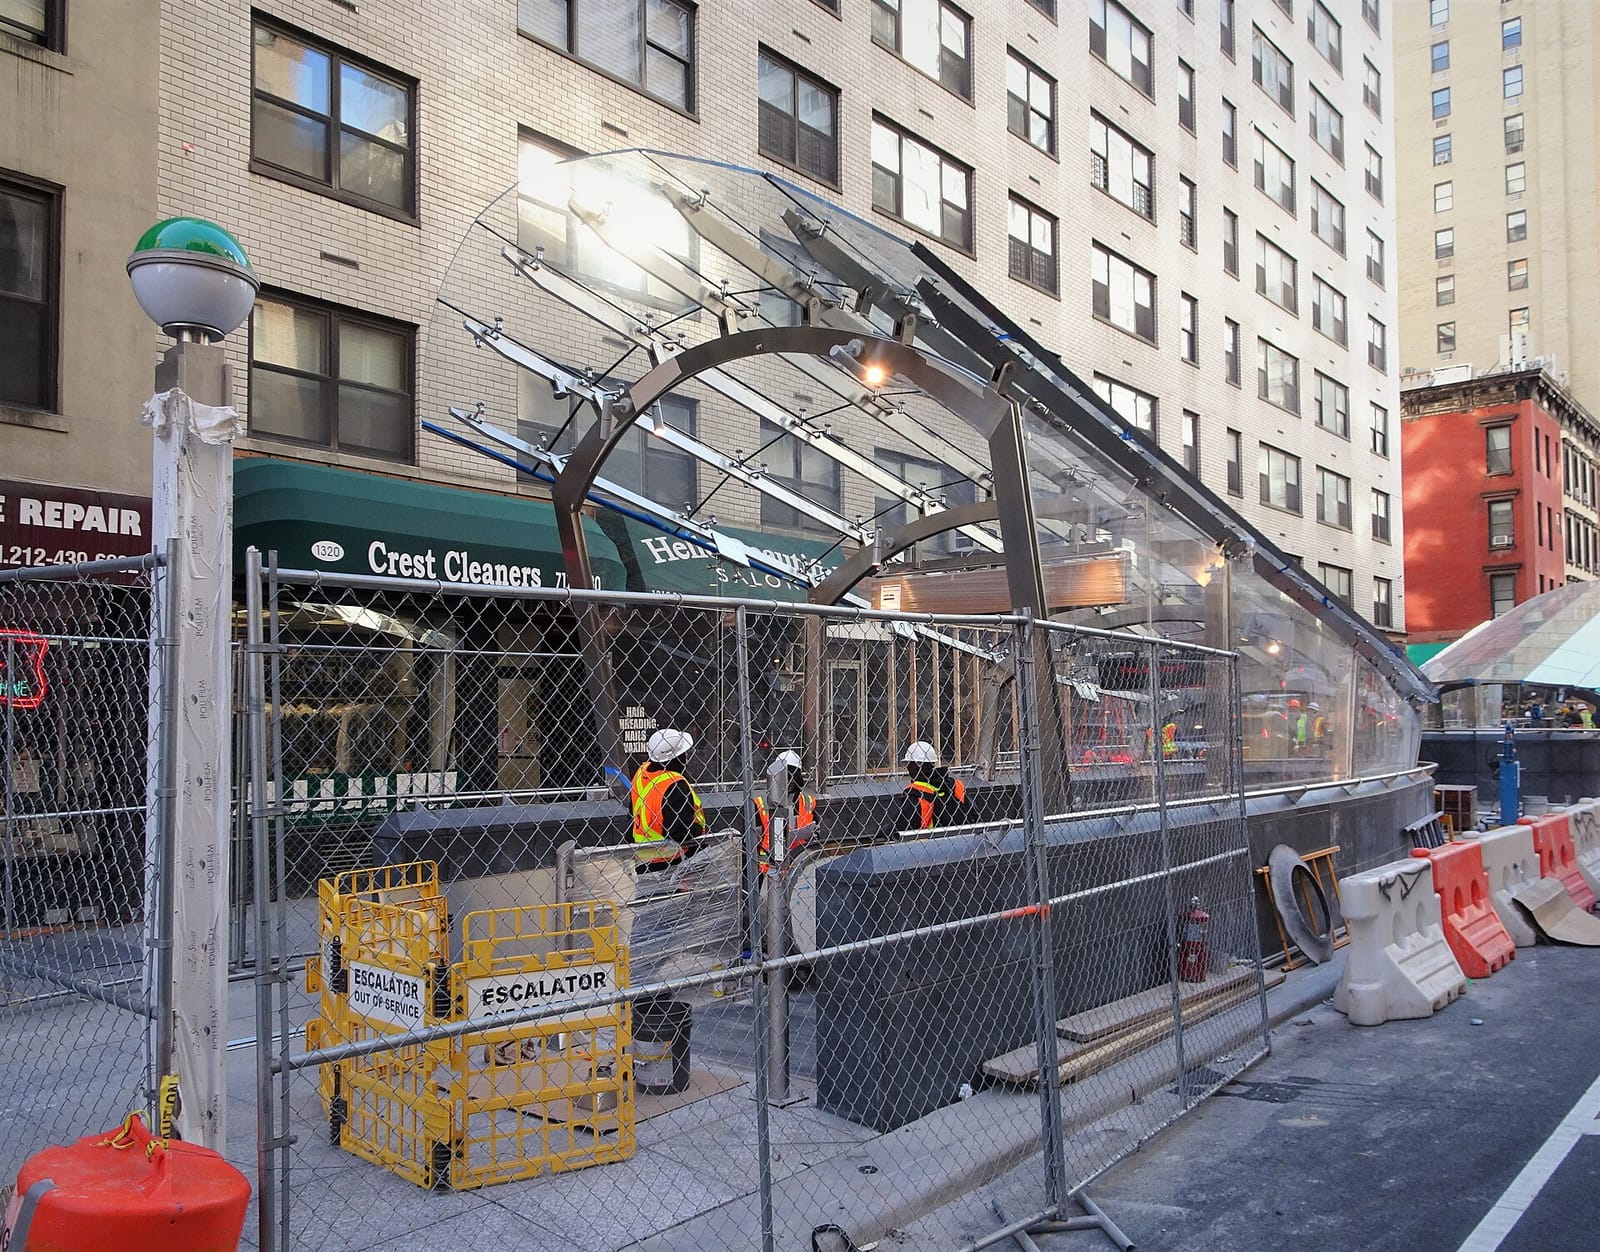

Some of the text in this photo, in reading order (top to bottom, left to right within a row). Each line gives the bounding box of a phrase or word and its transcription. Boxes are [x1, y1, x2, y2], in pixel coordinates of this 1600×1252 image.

[19, 497, 142, 537] REPAIR
[315, 544, 340, 557] 1320
[368, 540, 437, 579] Crest
[444, 551, 542, 588] Cleaners
[626, 706, 645, 718] HAIR
[354, 968, 418, 1001] ESCALATOR
[482, 971, 607, 1006] ESCALATOR
[354, 990, 419, 1019] OUT OF SERVICE
